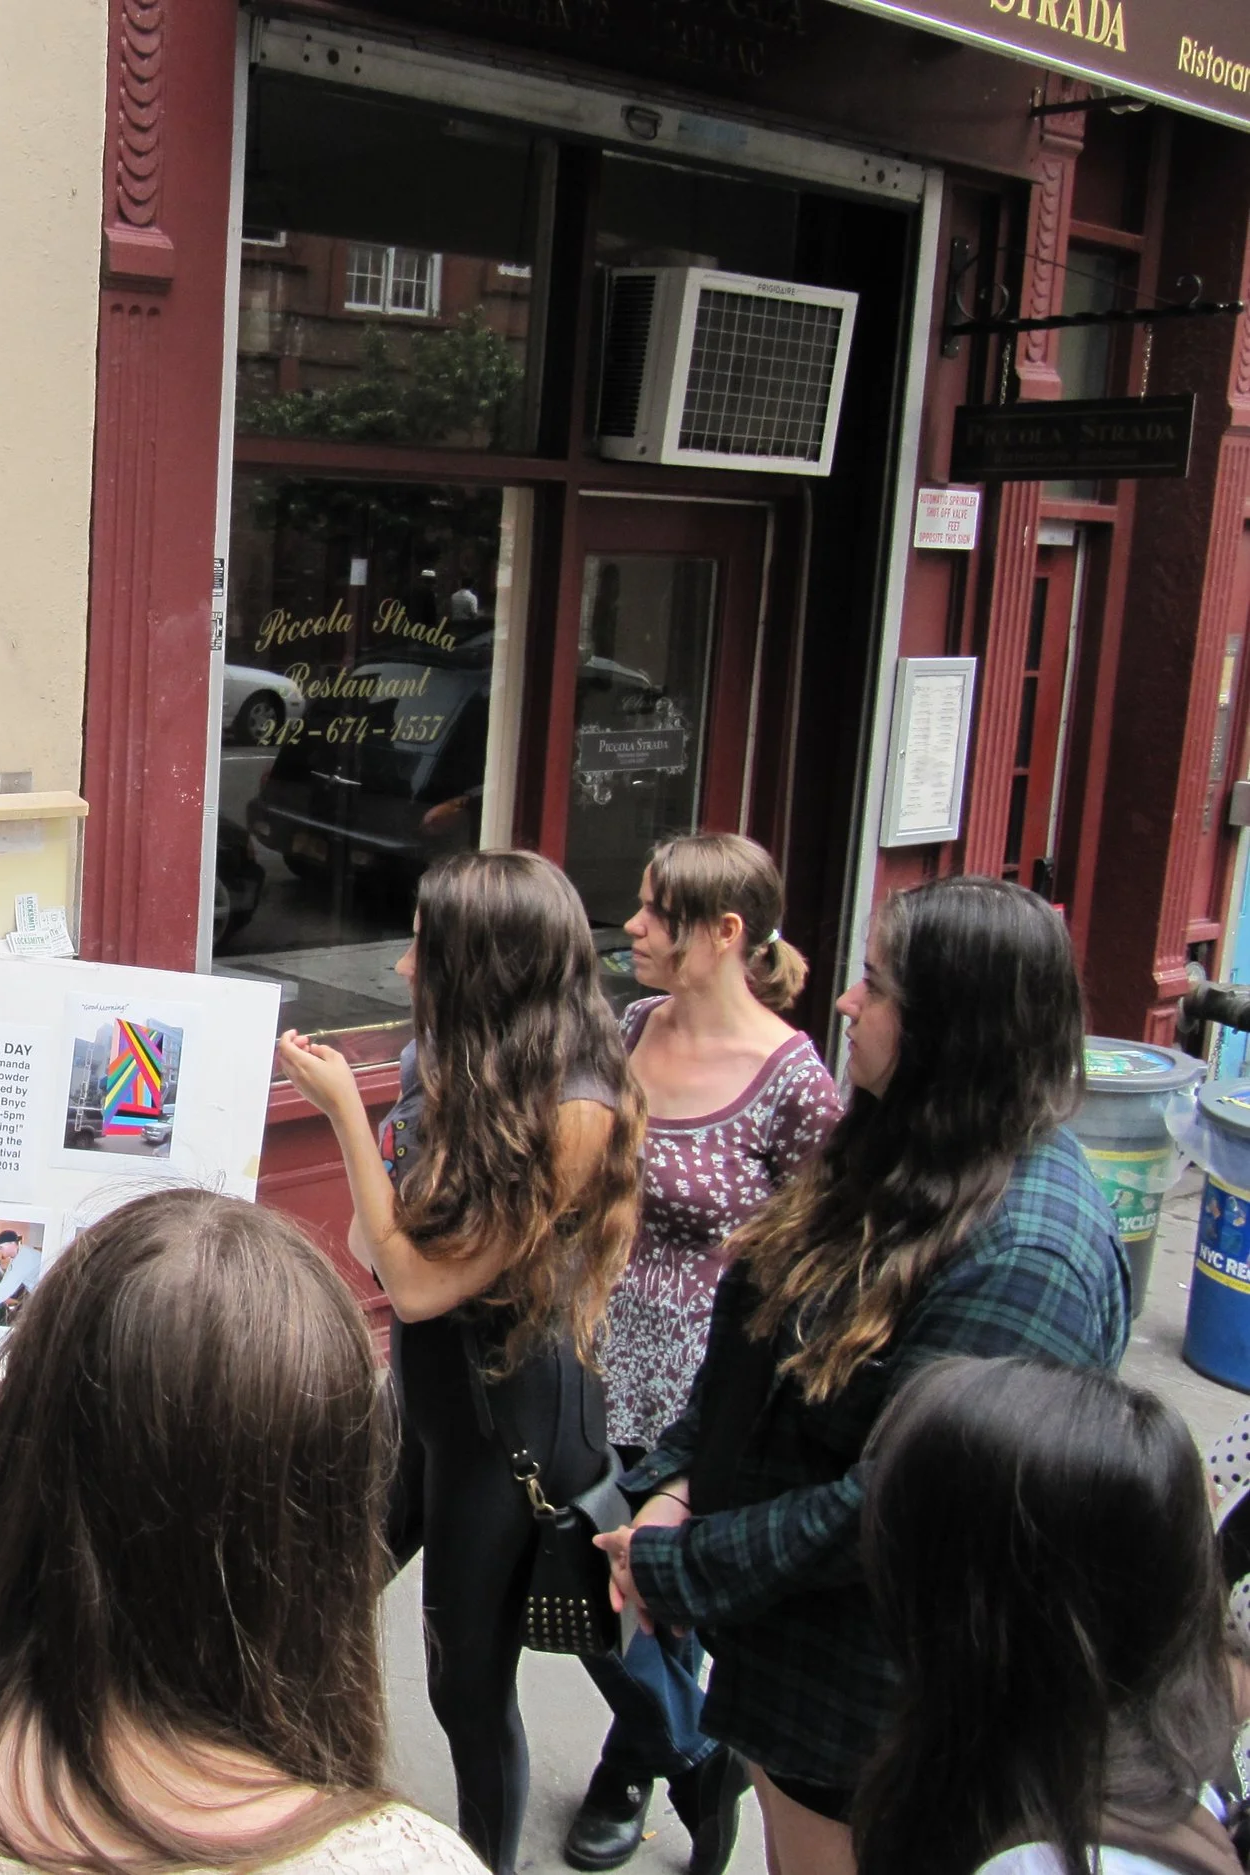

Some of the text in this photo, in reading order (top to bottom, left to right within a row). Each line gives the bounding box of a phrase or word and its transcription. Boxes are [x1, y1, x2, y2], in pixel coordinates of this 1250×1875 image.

[990, 0, 1126, 52] RADA
[966, 417, 1177, 446] PICCOLA STRADA
[920, 493, 977, 506] AUTOMATIC SPRINKLER
[940, 507, 951, 519] OFF
[953, 509, 968, 519] VALVE
[948, 521, 960, 531] FEET
[918, 532, 971, 544] OPPOSITE THIS SIGN
[255, 598, 354, 652] Piccola
[373, 598, 457, 652] Strada
[278, 662, 432, 698] Restaurant
[599, 738, 669, 752] PICCOLA STRADA
[4, 1042, 33, 1056] DAY
[15, 1086, 28, 1097] by
[6, 1135, 22, 1146] the
[1199, 1243, 1250, 1281] NYC RE
